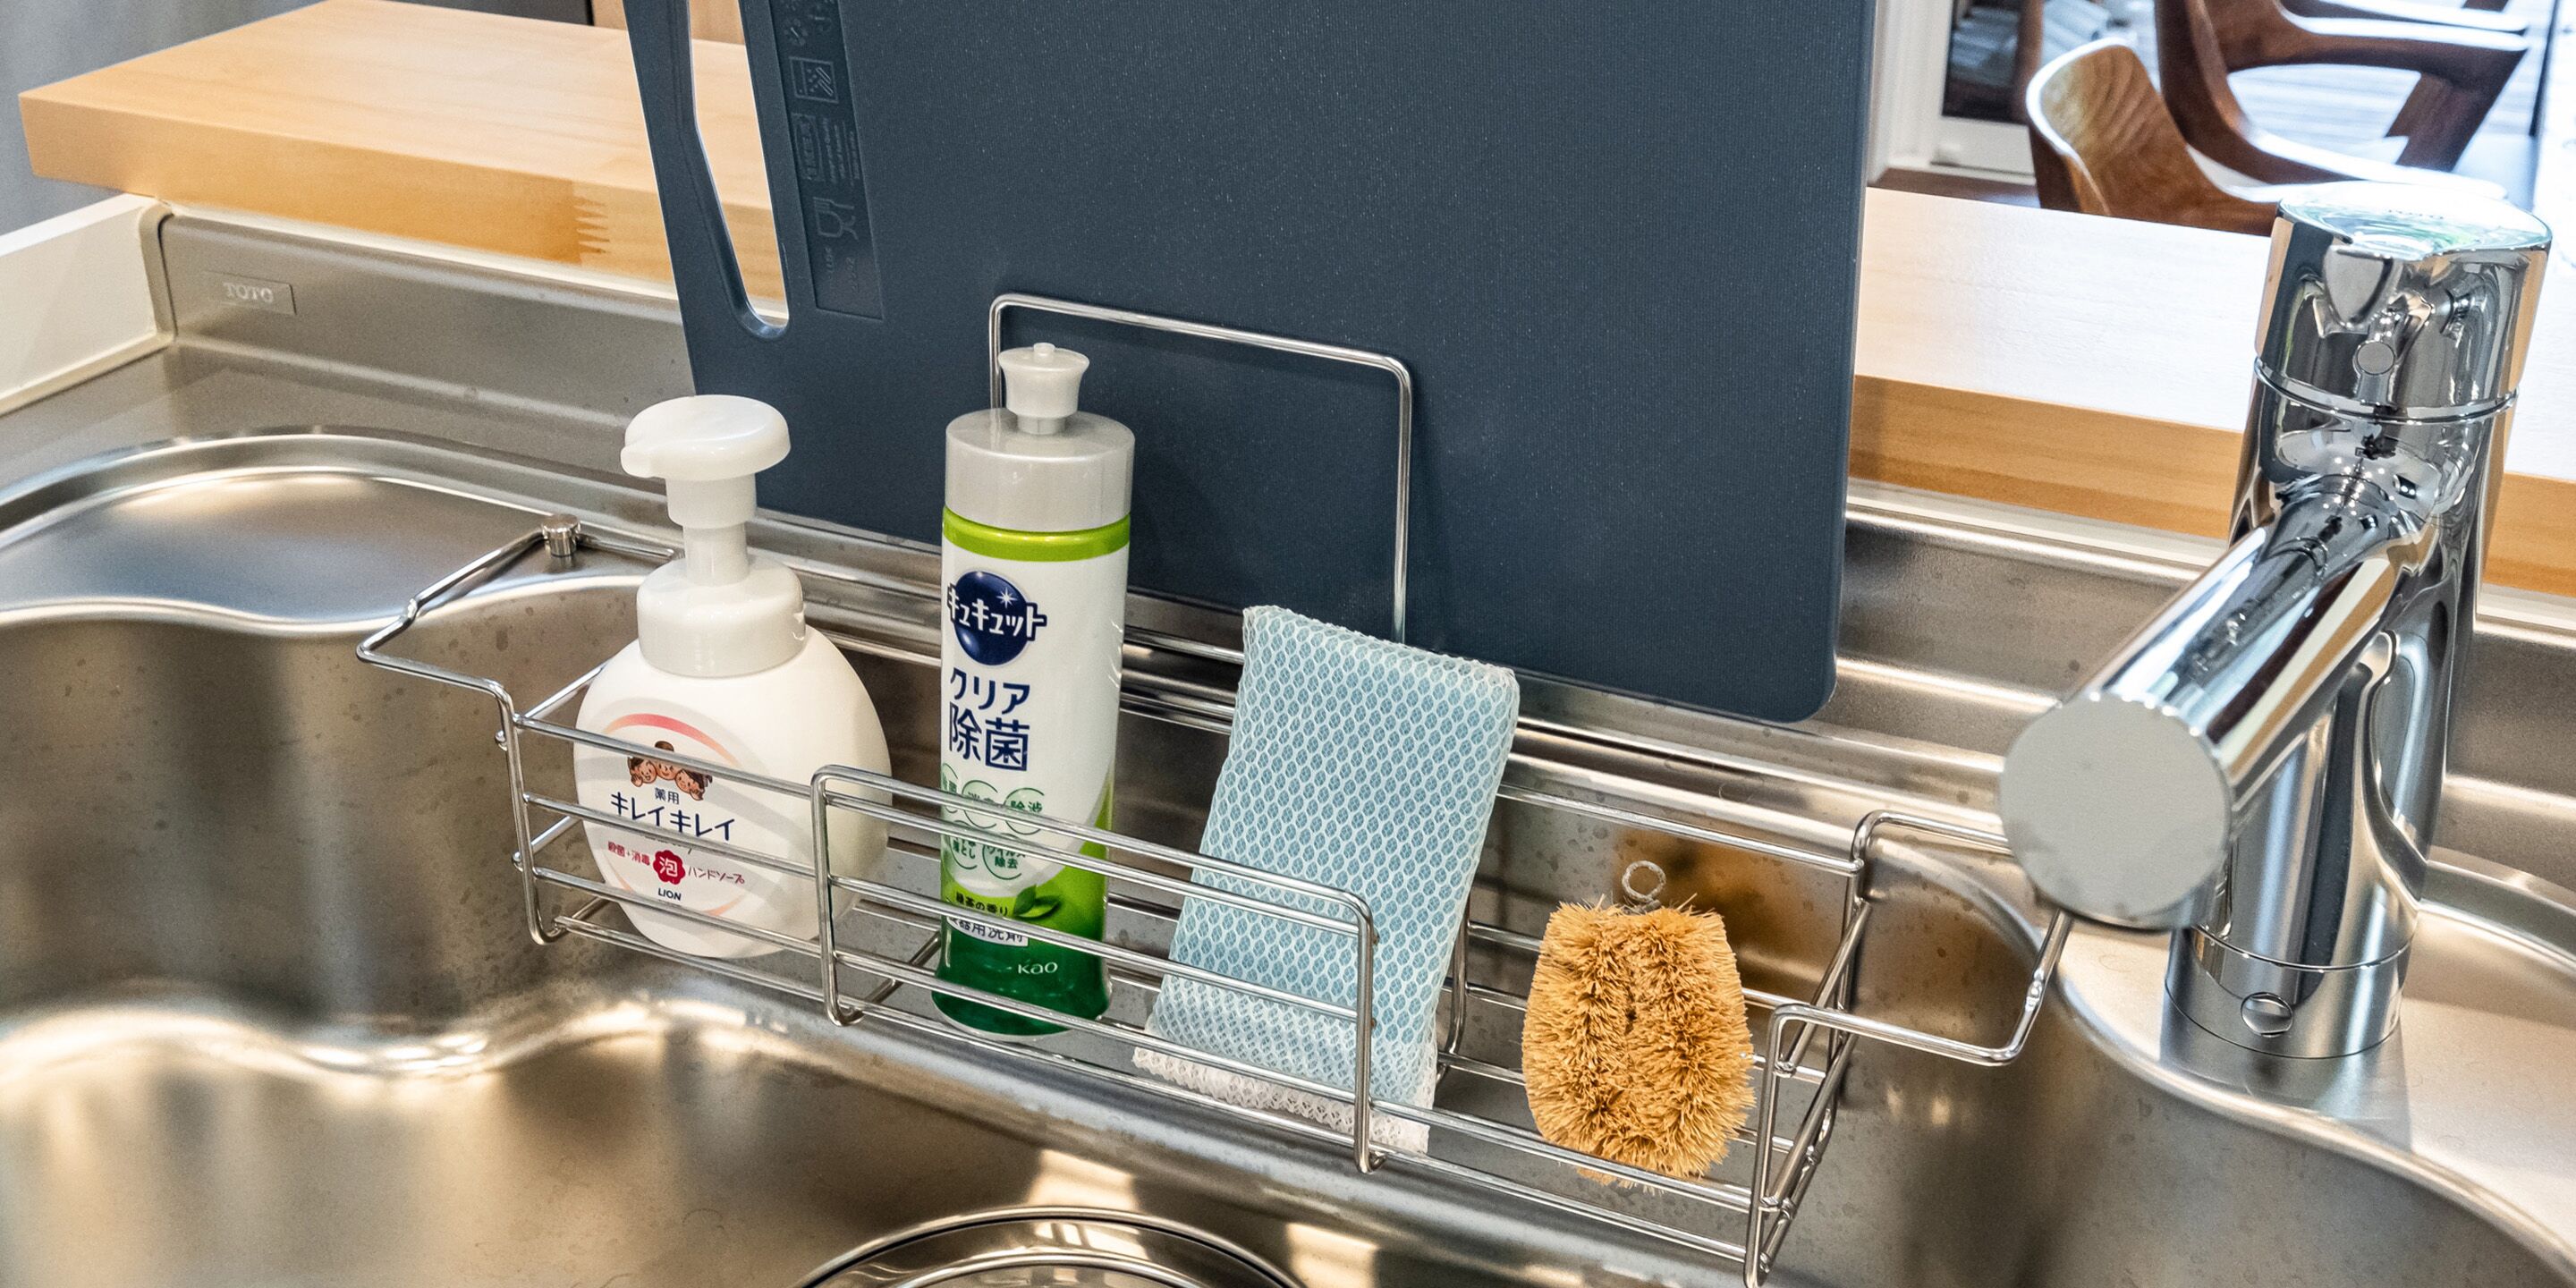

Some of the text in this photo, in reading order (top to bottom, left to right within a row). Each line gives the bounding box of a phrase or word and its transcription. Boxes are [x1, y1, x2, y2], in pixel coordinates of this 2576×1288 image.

[223, 282, 274, 303] TOTO
[948, 586, 1045, 639] キュキュット
[950, 667, 1030, 715] クリア
[949, 702, 1030, 771] 除菌
[655, 786, 680, 806] 薬用
[611, 792, 734, 841] キレイキレイ
[658, 856, 679, 878] 泡
[688, 865, 745, 885] ハンドソープ
[657, 887, 682, 901] LION
[955, 892, 1008, 917] 緑茶の香り
[1017, 960, 1058, 976] Kao
